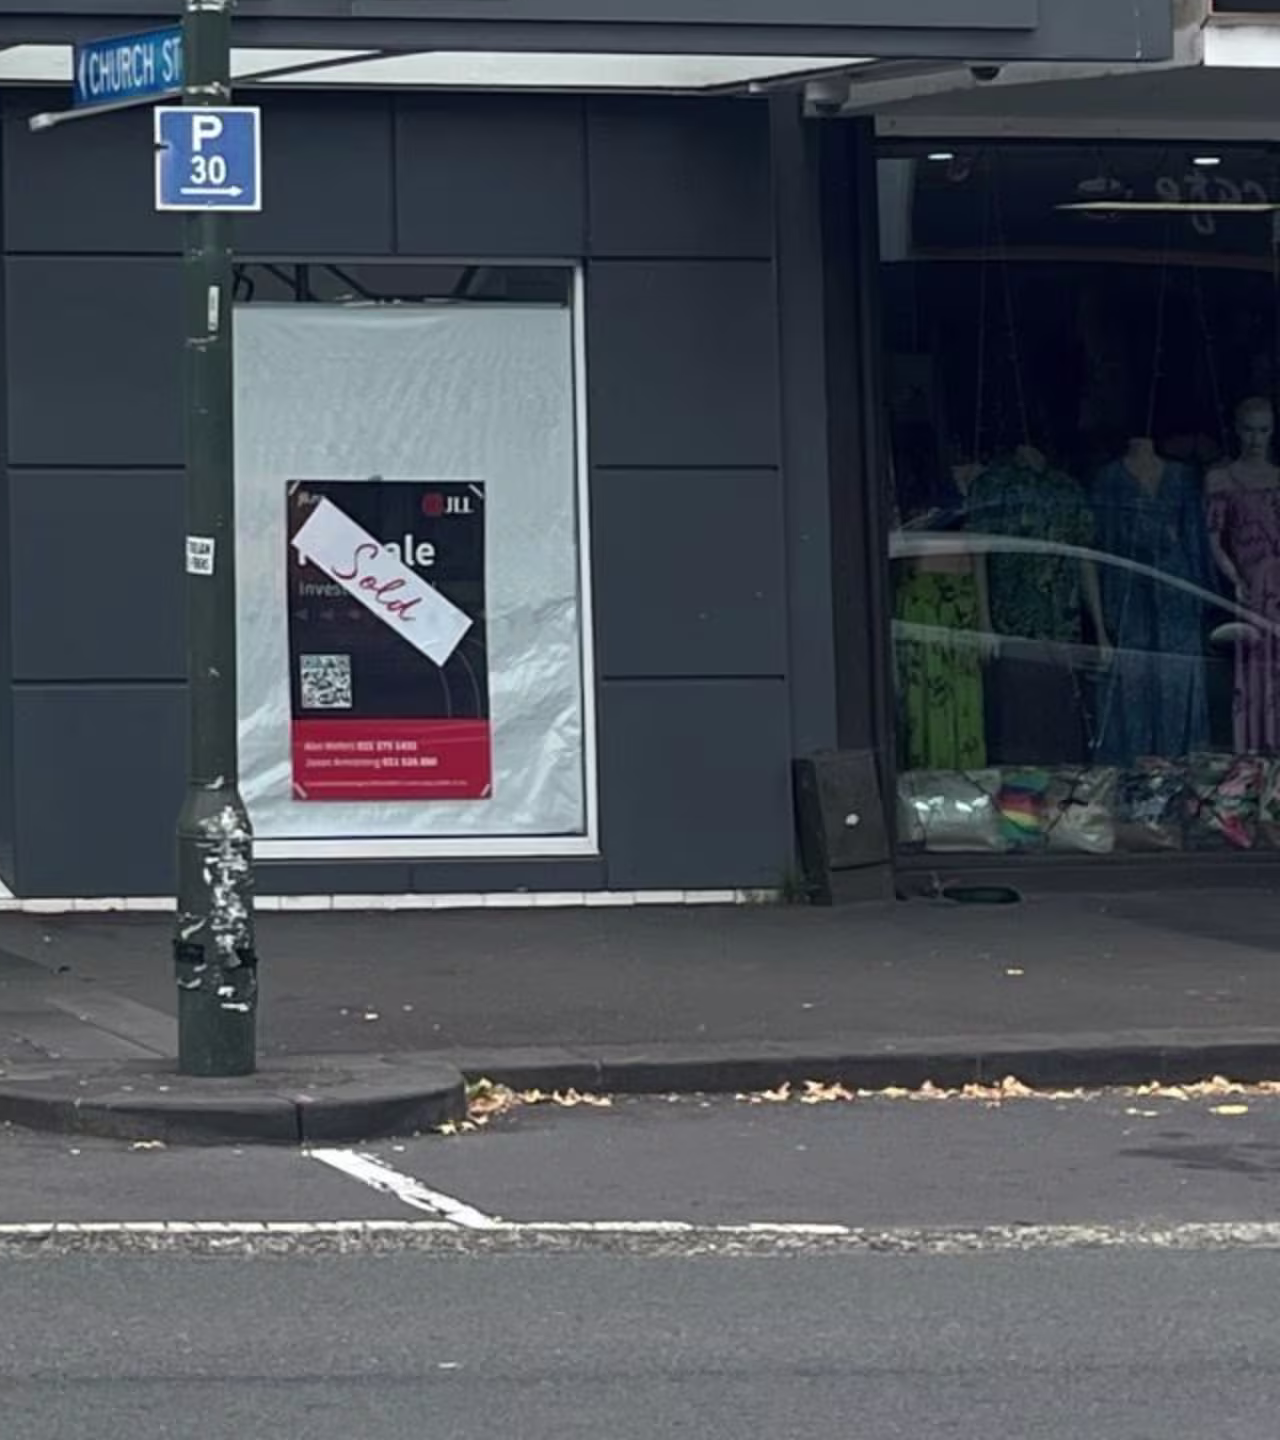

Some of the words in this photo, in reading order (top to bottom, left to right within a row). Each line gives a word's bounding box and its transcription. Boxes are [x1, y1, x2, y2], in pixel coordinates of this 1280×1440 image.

[88, 42, 155, 96] CHURCH
[162, 36, 182, 82] ST
[192, 115, 223, 151] P
[190, 156, 227, 185] 30
[444, 496, 474, 514] JLL
[330, 542, 425, 623] Sold
